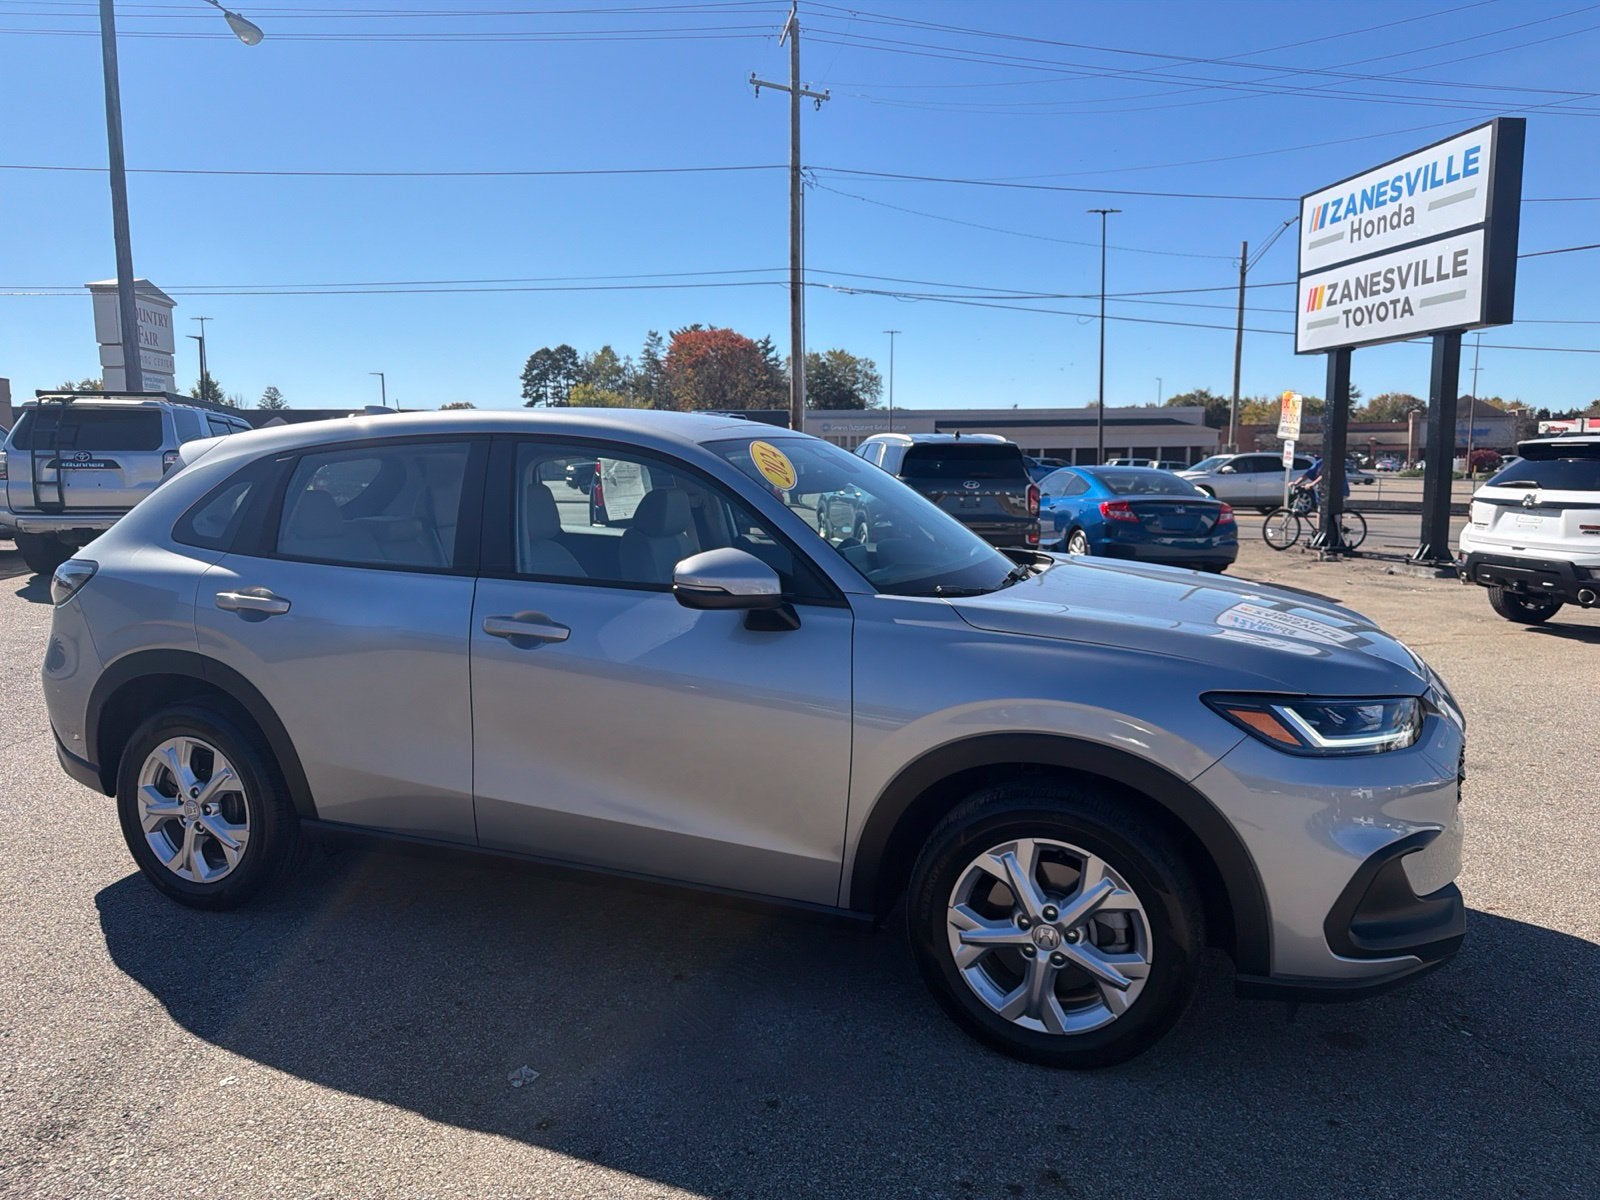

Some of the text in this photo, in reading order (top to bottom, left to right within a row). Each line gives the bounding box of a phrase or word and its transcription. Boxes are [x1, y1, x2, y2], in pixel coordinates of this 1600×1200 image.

[1329, 145, 1482, 225] ZANESVILLE
[1349, 203, 1415, 243] Honda
[1326, 248, 1469, 307] ZANESVILLE
[1342, 296, 1414, 328] TOYOTA
